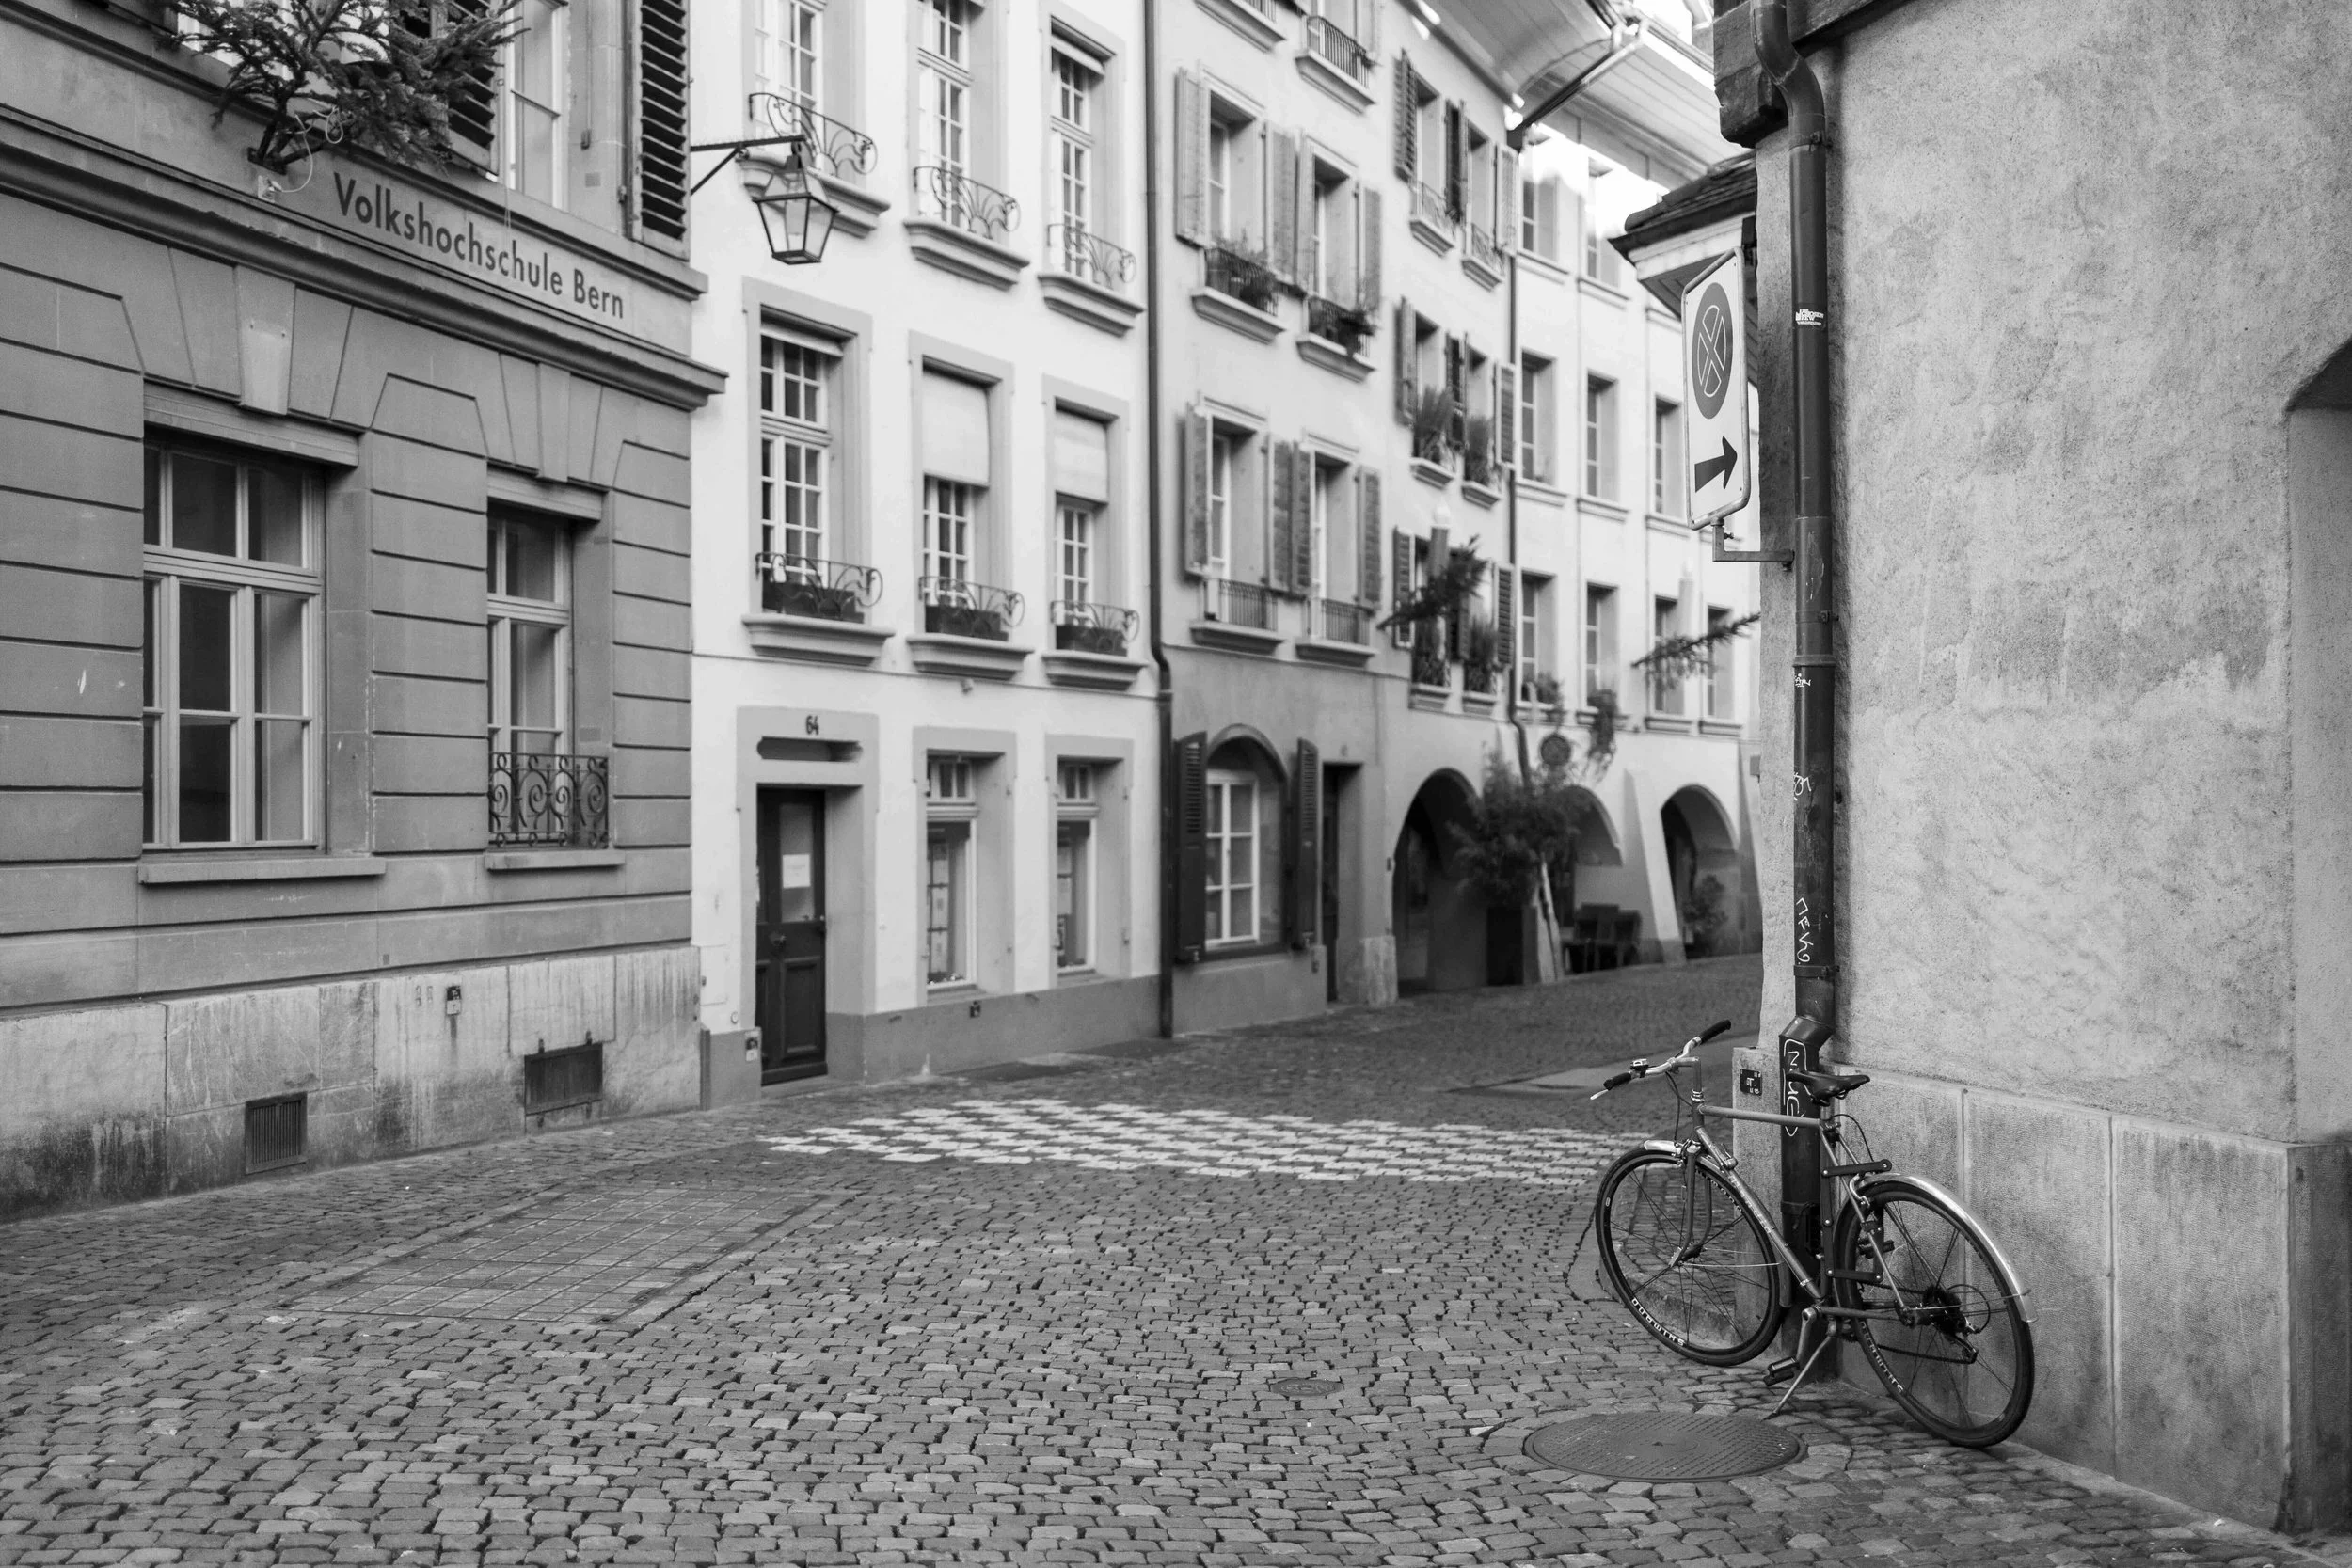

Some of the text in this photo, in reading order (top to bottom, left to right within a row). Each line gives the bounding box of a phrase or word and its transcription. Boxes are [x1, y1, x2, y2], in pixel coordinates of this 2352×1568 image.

[333, 172, 625, 319] Volkshochschule Bern
[805, 715, 820, 736] 64
[1631, 1297, 1685, 1347] SHIMANO
